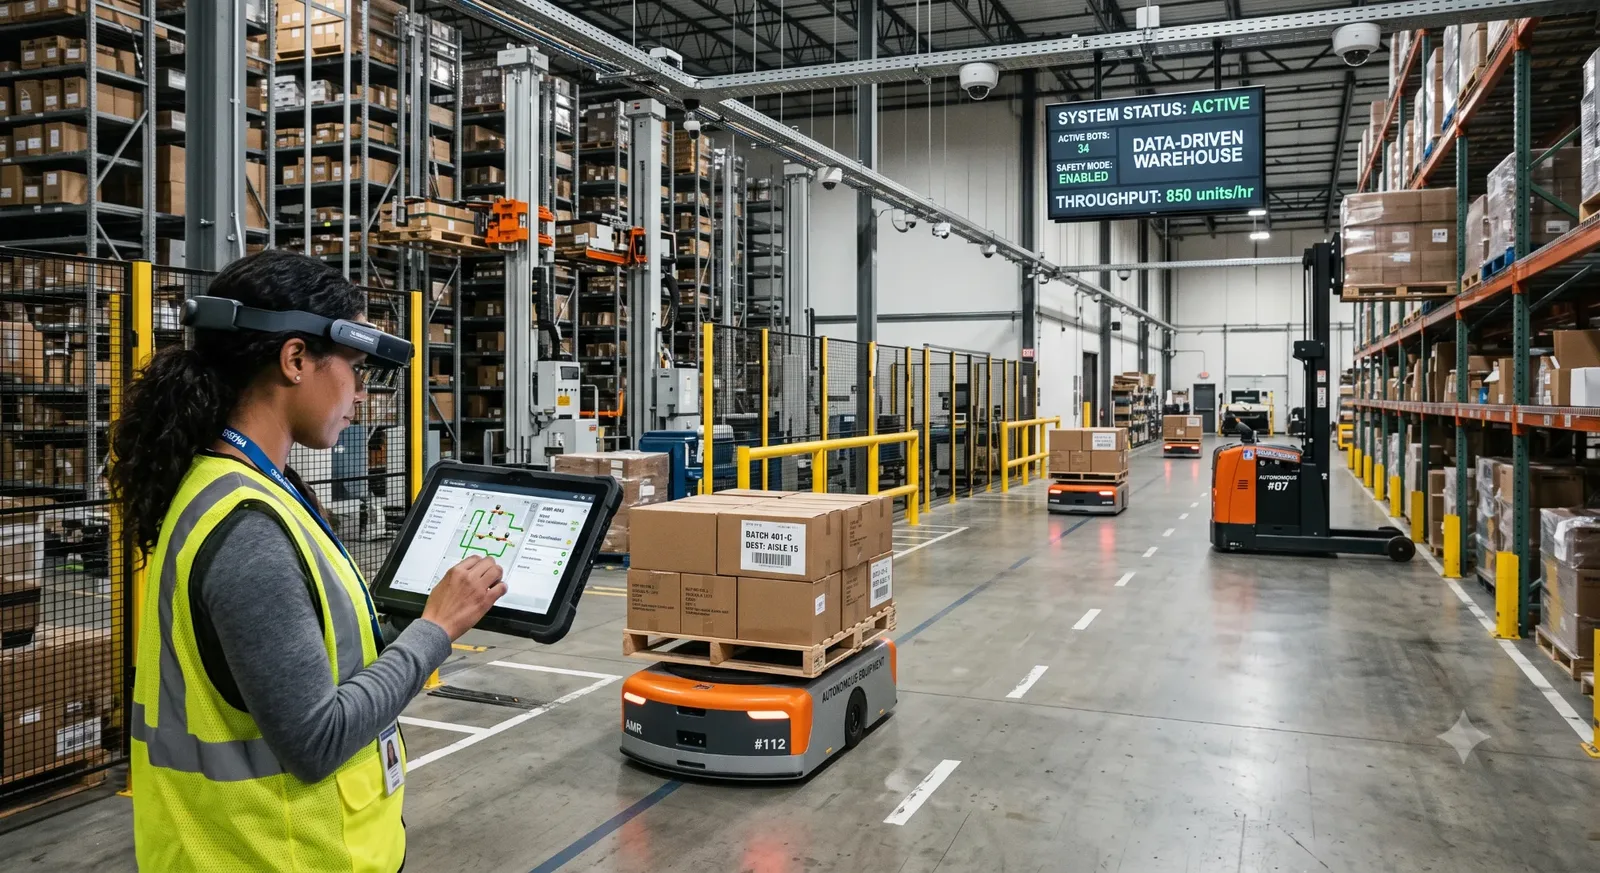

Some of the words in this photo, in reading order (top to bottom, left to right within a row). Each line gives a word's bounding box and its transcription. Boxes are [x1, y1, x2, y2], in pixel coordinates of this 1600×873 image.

[1058, 107, 1119, 125] SYSTEM
[1123, 102, 1188, 120] STATUS:
[1191, 96, 1250, 114] ACTIVE
[1058, 133, 1085, 143] ACTIVE
[1086, 131, 1110, 141] BOTS:
[1133, 130, 1243, 152] DATA-DRIVEN
[1077, 143, 1090, 154] 34
[1133, 147, 1243, 168] WAREHOUSE
[1056, 162, 1086, 172] SAFETY
[1087, 160, 1113, 170] MODE:
[1059, 171, 1109, 184] ENABLED
[1056, 189, 1161, 209] THROUGHPUT:
[1166, 188, 1192, 202] 850
[1196, 185, 1254, 201] units/hr
[1267, 481, 1289, 491] #07
[745, 530, 769, 540] BATCH
[771, 533, 793, 541] 401-C
[745, 541, 766, 550] DEST:
[767, 543, 788, 552] AISLE
[790, 545, 799, 553] 15
[625, 719, 642, 735] AMR
[754, 738, 786, 751] #112
